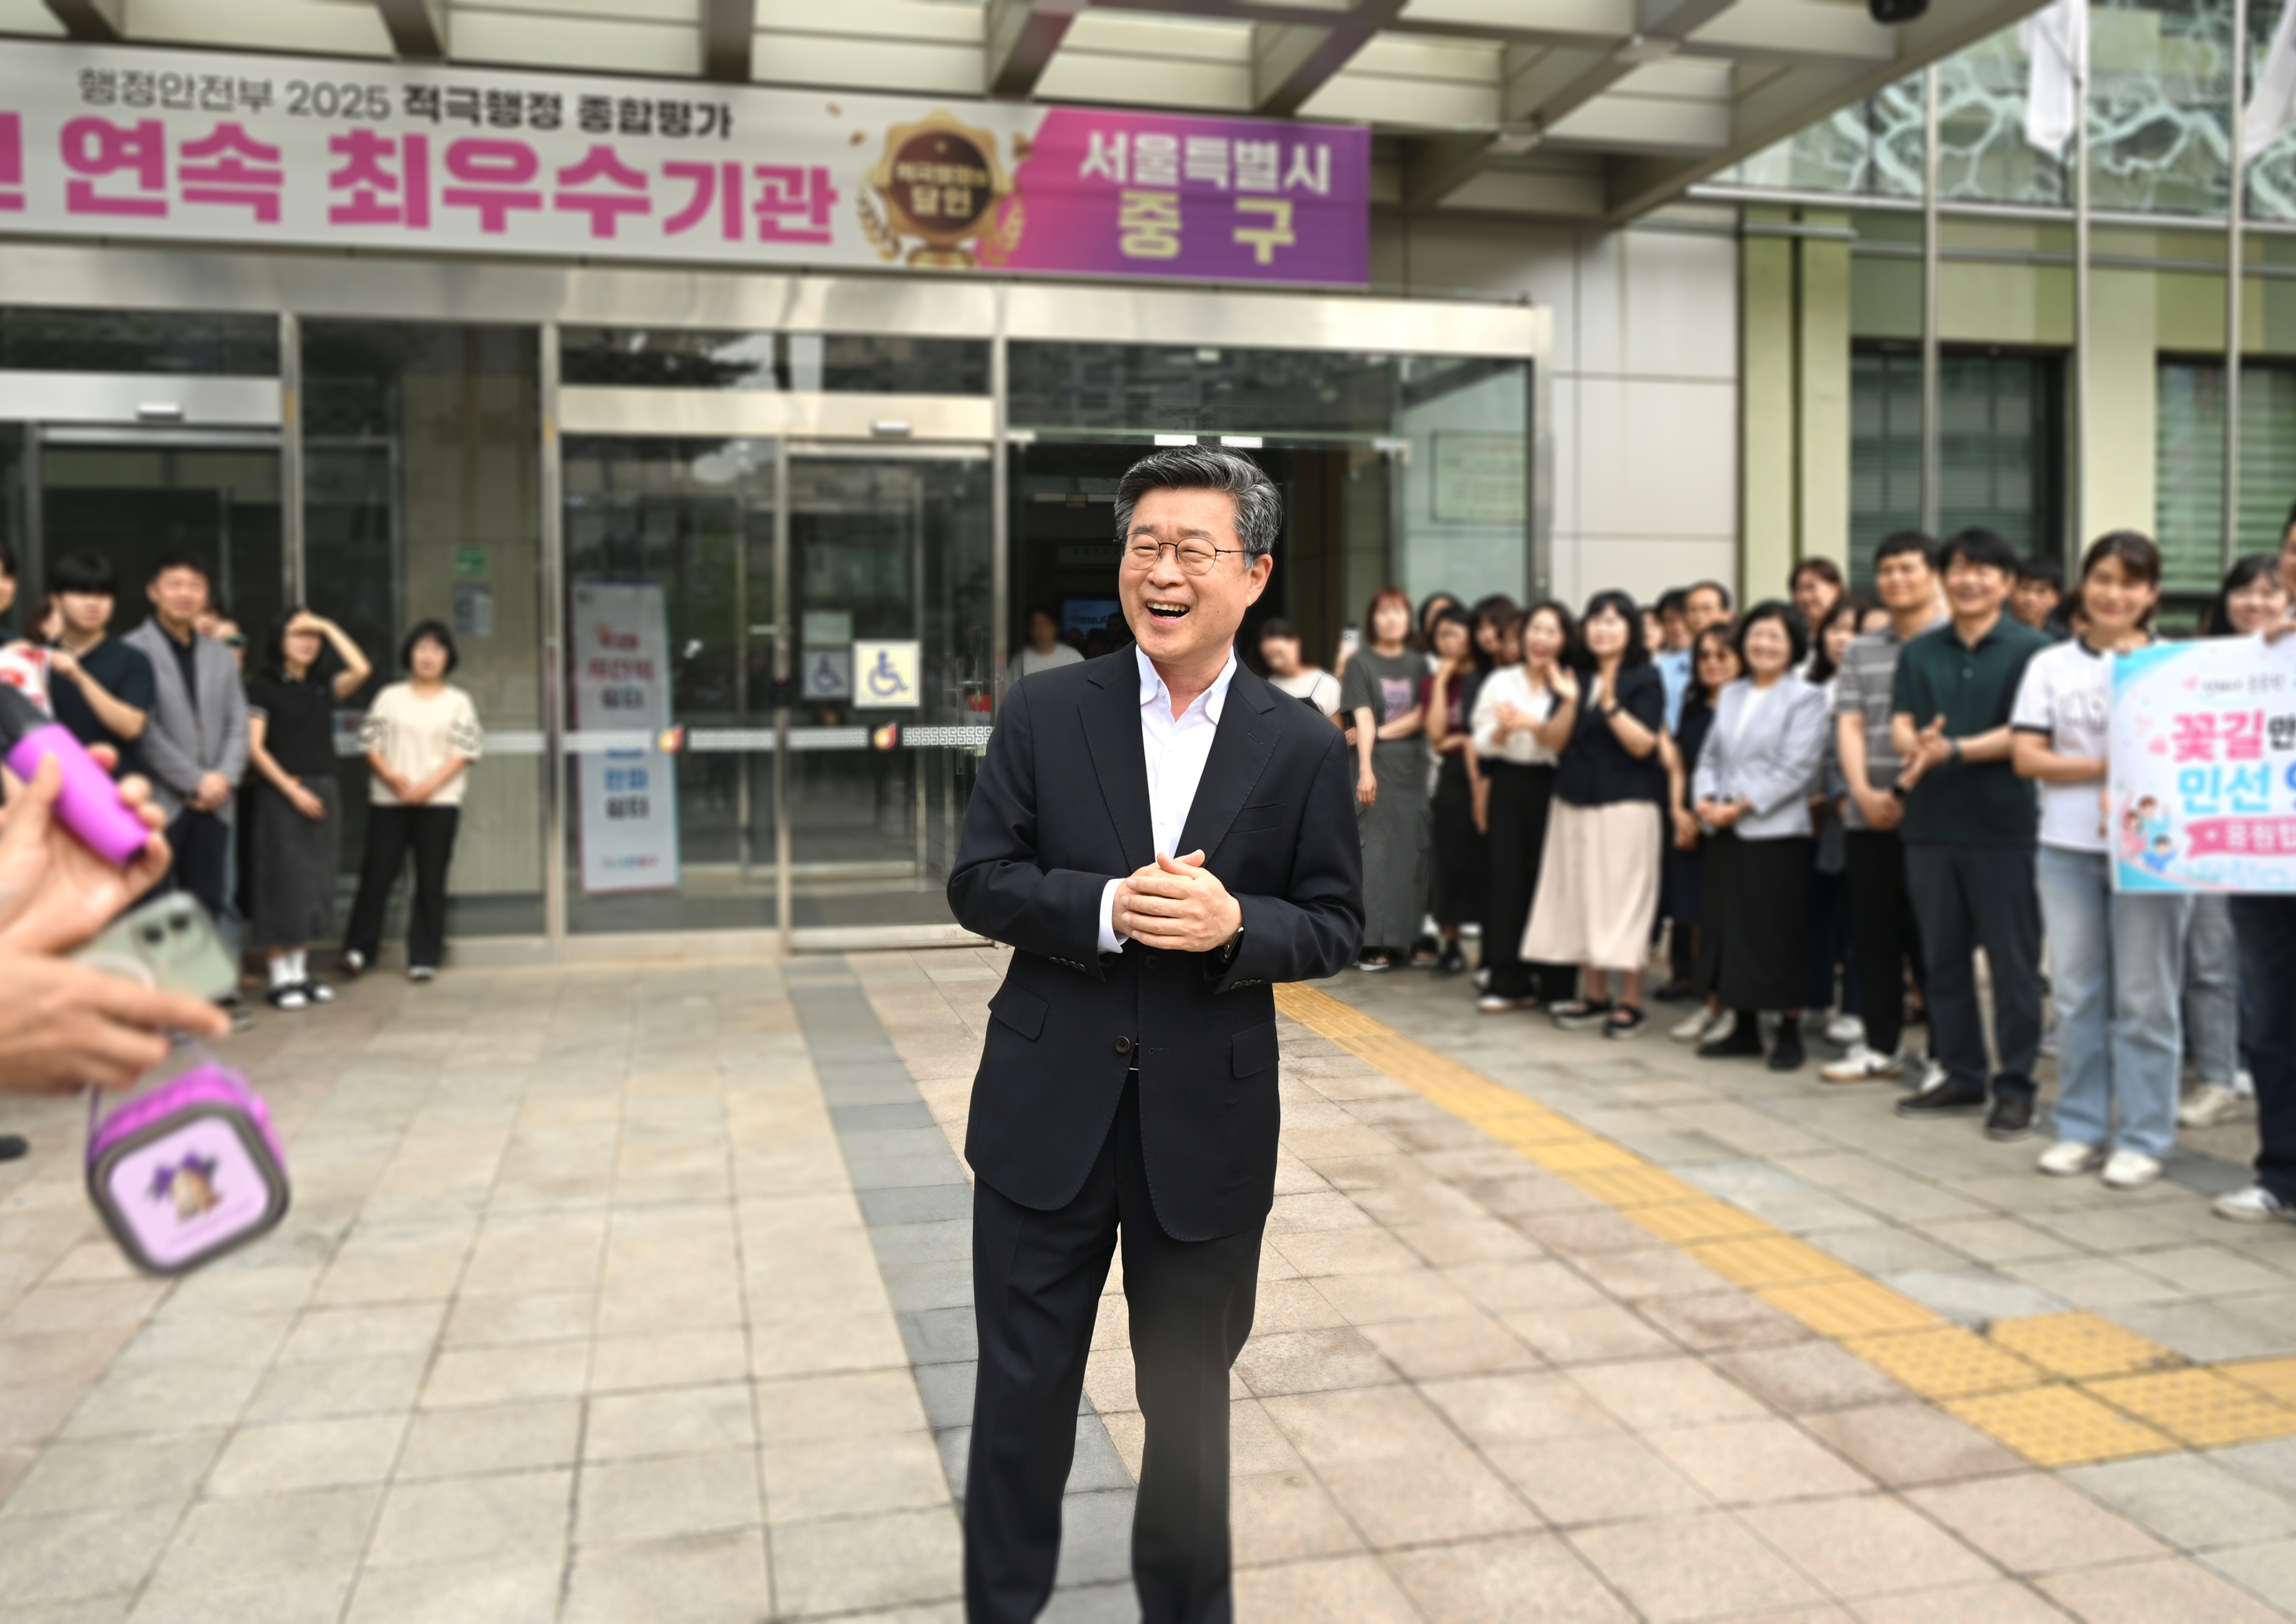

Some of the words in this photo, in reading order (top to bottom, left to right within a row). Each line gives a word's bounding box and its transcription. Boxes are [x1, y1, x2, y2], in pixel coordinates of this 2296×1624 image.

[78, 67, 275, 115] 행정안전부
[284, 80, 392, 122] 2025
[402, 83, 563, 132] 적극행정
[577, 92, 733, 142] 종합평가
[59, 114, 284, 224] 연속
[328, 127, 839, 246] 최우수기관
[1079, 131, 1331, 196] 서울특별시
[912, 184, 972, 218] 달인
[2177, 762, 2271, 814] 민선
